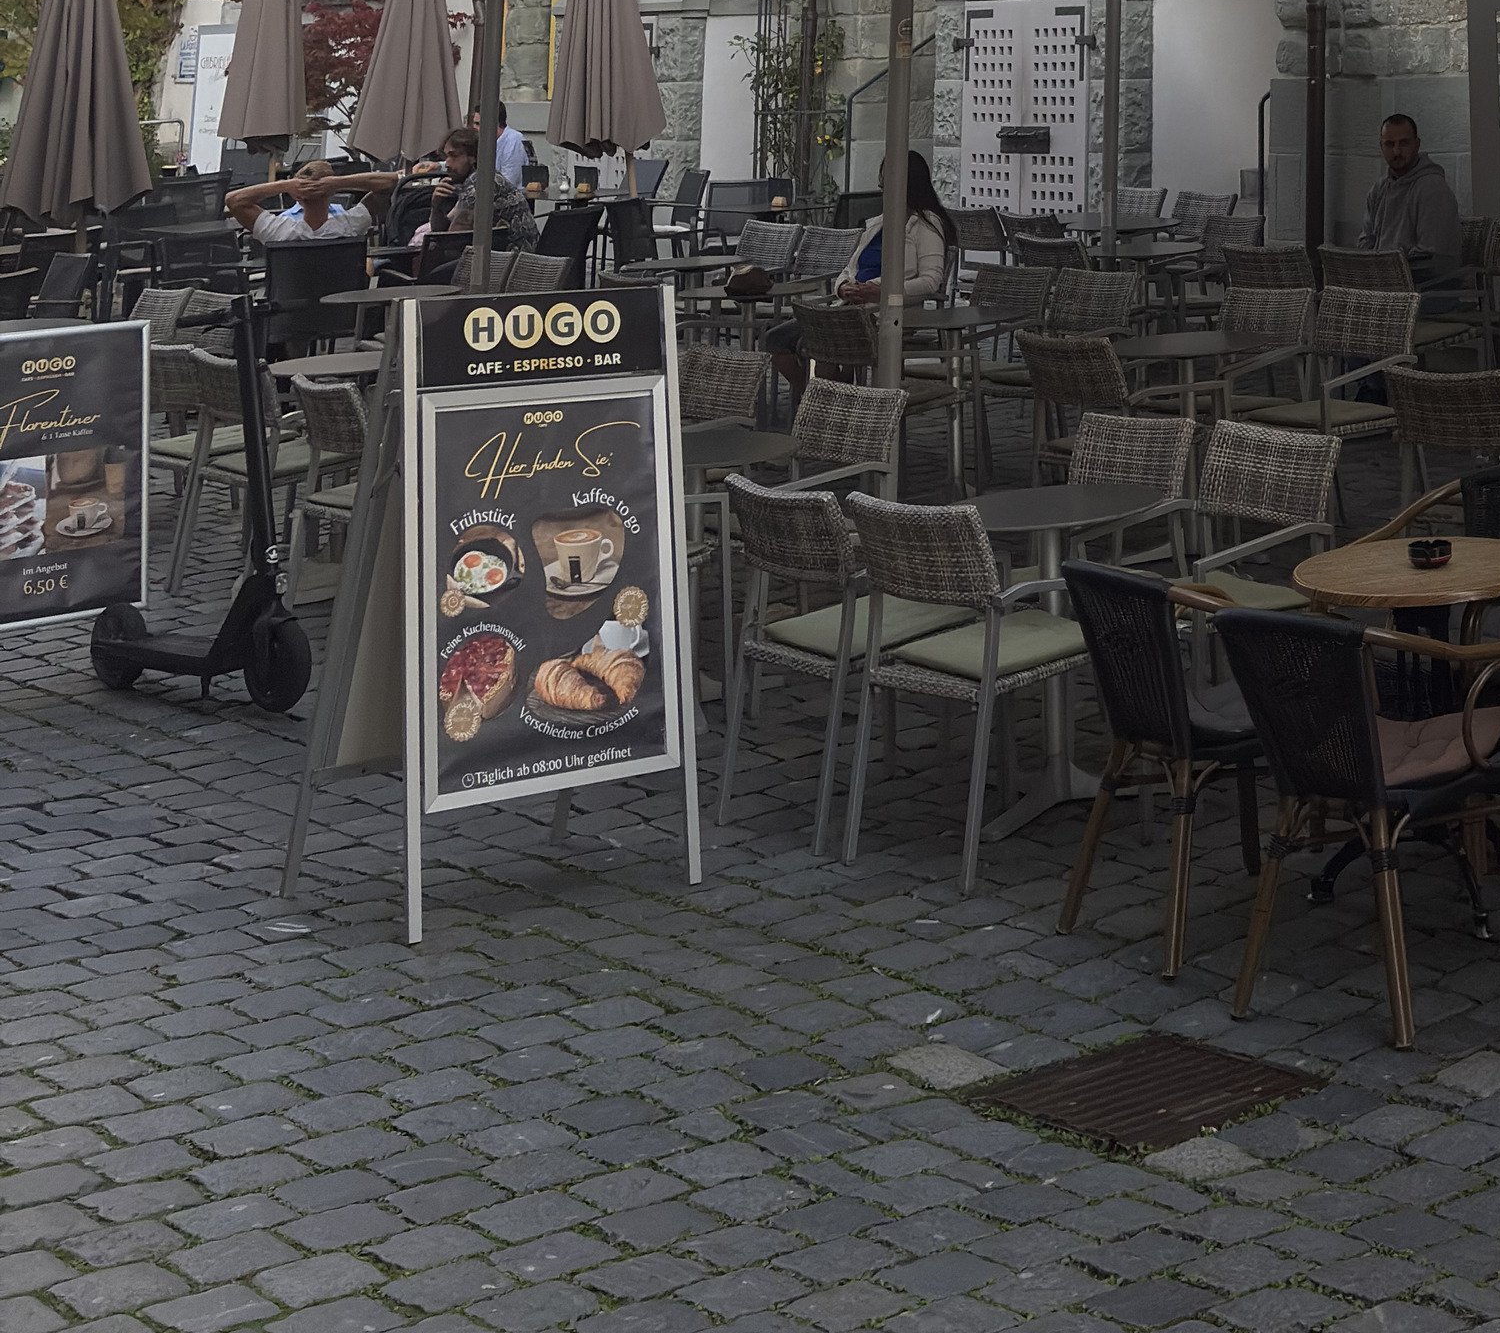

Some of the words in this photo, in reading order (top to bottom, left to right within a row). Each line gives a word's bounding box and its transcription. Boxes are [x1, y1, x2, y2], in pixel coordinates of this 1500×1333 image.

[467, 304, 618, 347] HUGO
[22, 356, 75, 374] HUGO
[467, 361, 503, 375] CAFE
[514, 356, 583, 372] ESPRESSO
[594, 353, 622, 367] BAR
[0, 389, 101, 450] Florentiner
[524, 410, 563, 425] HUGO
[465, 432, 528, 499] Hier
[526, 449, 575, 478] finden
[450, 509, 517, 535] Frühstück
[572, 488, 615, 507] Kaffee
[616, 501, 630, 517] to
[624, 515, 641, 534] go
[23, 578, 55, 595] 6,50
[59, 574, 68, 589] €
[36, 562, 68, 574] Angebot
[440, 634, 463, 659] Feine
[462, 621, 527, 652] Kuchenauswahl
[519, 706, 584, 740] Verschiedene
[586, 705, 639, 738] Croissants
[474, 767, 513, 785] Täglich
[516, 762, 530, 776] ab
[532, 759, 562, 775] 08:00
[564, 754, 585, 769] Uhr
[587, 746, 632, 768] geöffnet
